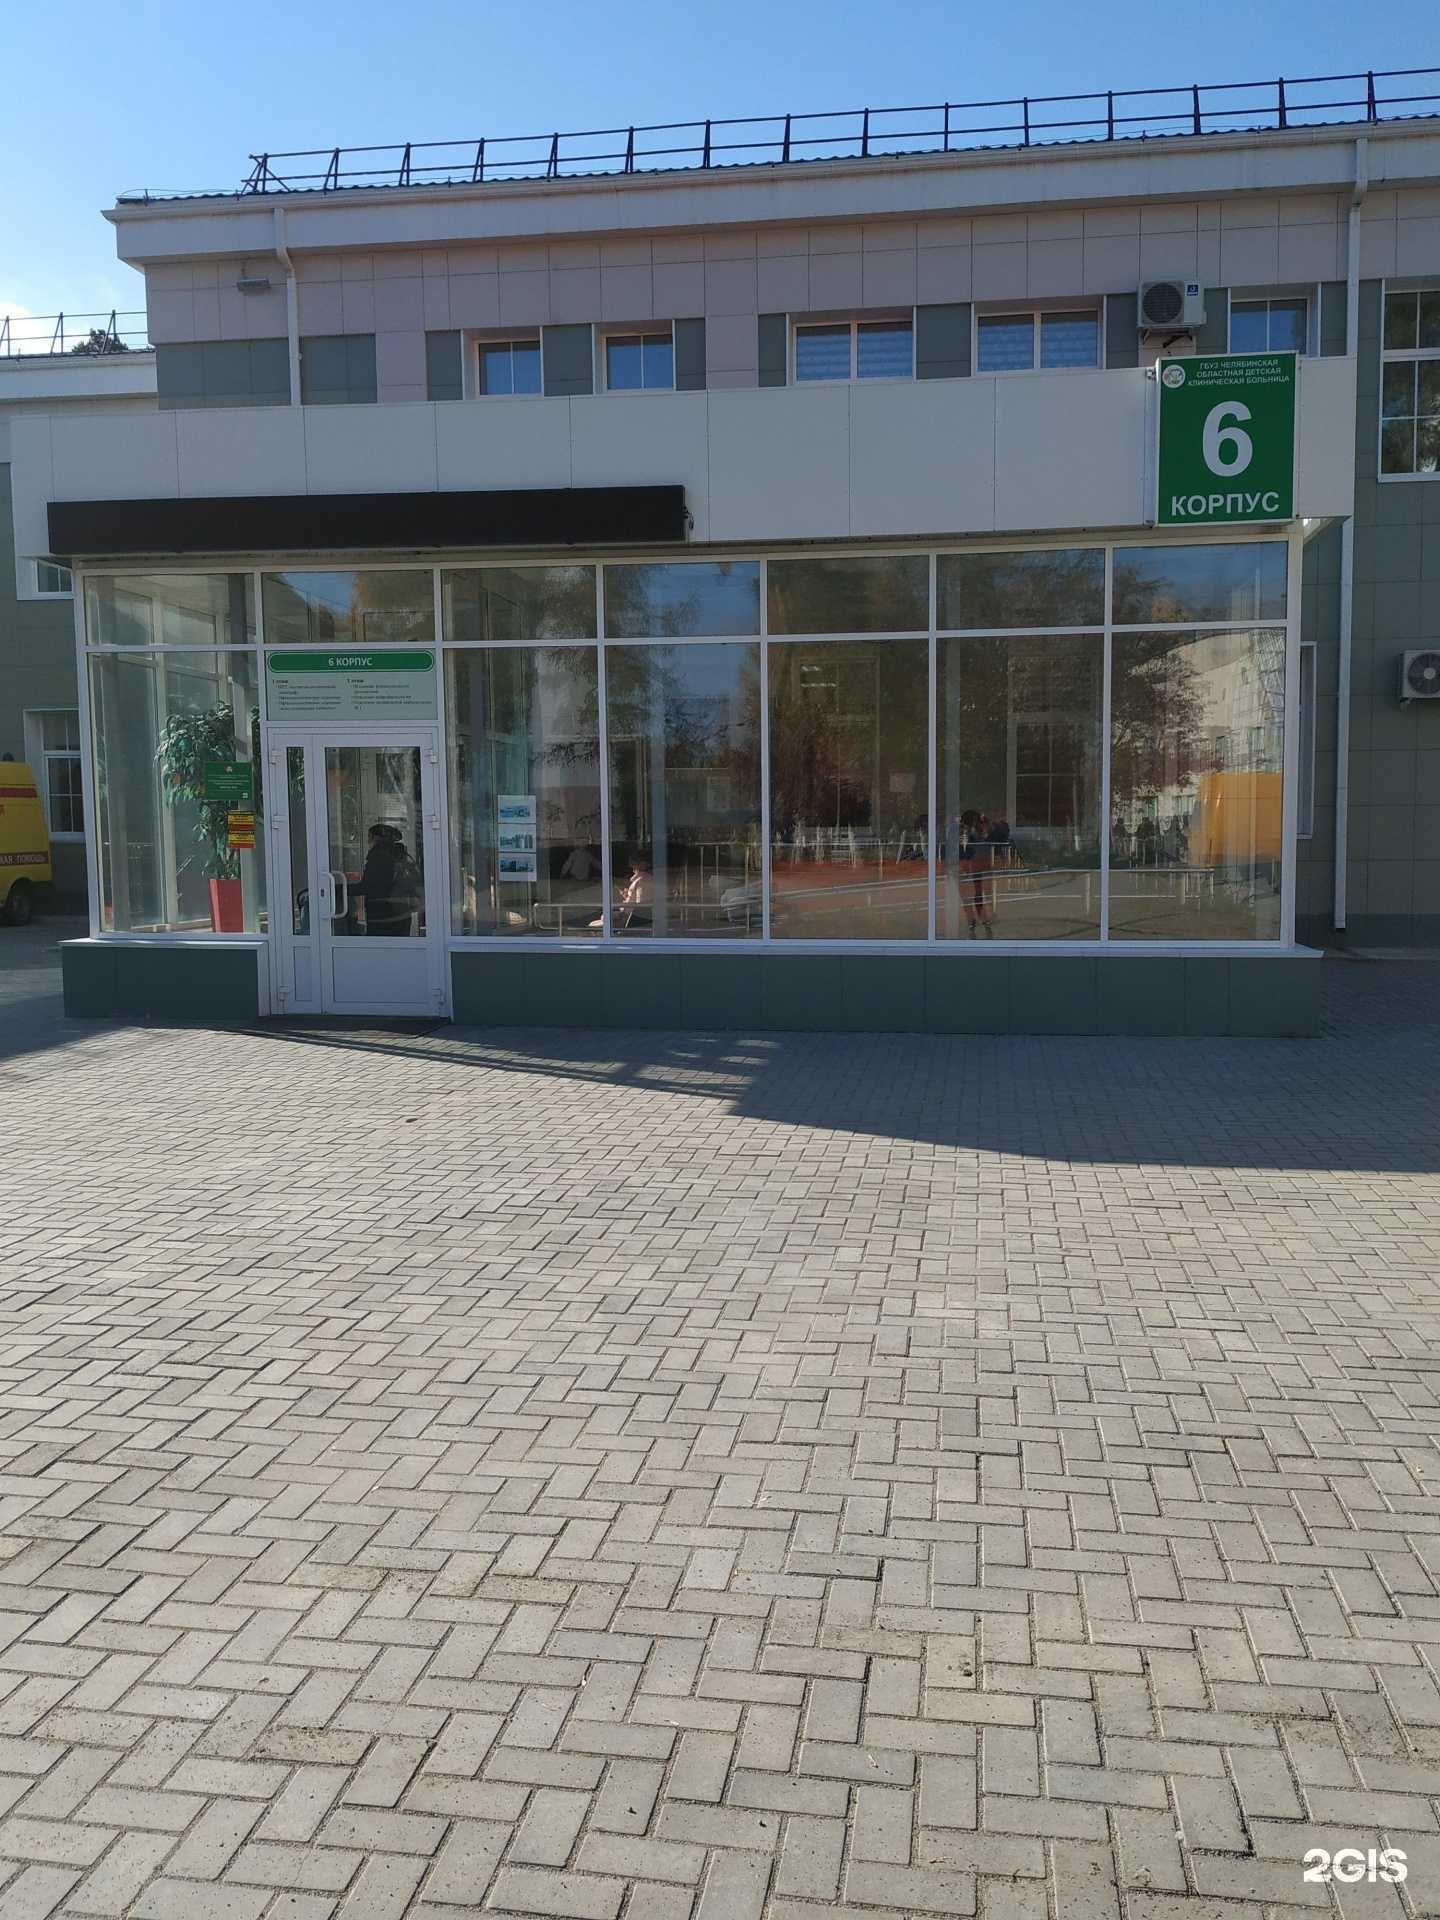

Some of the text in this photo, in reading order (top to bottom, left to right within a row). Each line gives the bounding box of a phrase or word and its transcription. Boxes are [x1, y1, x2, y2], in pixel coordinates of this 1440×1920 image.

[1221, 360, 1278, 369] ЧЕЛЯБИНСКАЯ
[1197, 368, 1281, 378] ОБЛАСТНАЯ ДЕТСКАЯ
[1188, 375, 1290, 386] КЛИНИЧЕСКАЯ БОЛЬНИЦА
[1202, 400, 1253, 477] 6
[1171, 491, 1280, 516] КОРПУС
[328, 657, 373, 667] 6 КОРПУС
